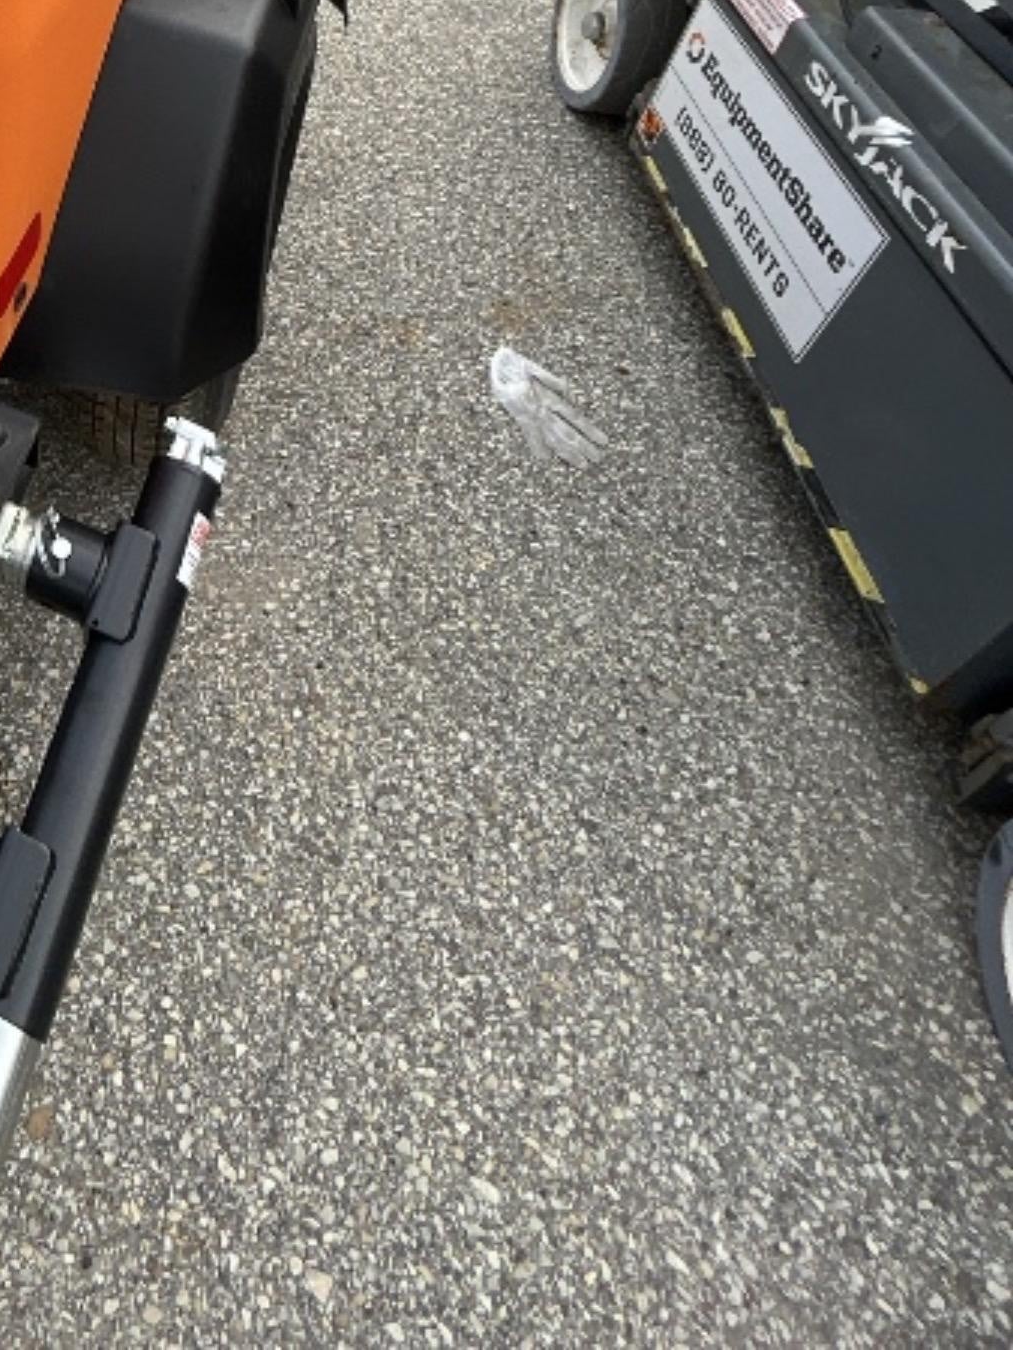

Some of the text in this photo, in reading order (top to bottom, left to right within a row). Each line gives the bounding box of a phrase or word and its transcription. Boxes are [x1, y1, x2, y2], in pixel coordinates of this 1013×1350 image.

[674, 105, 716, 173] (888)
[700, 52, 847, 274] EquipmentShare
[804, 60, 969, 274] SKYJACK
